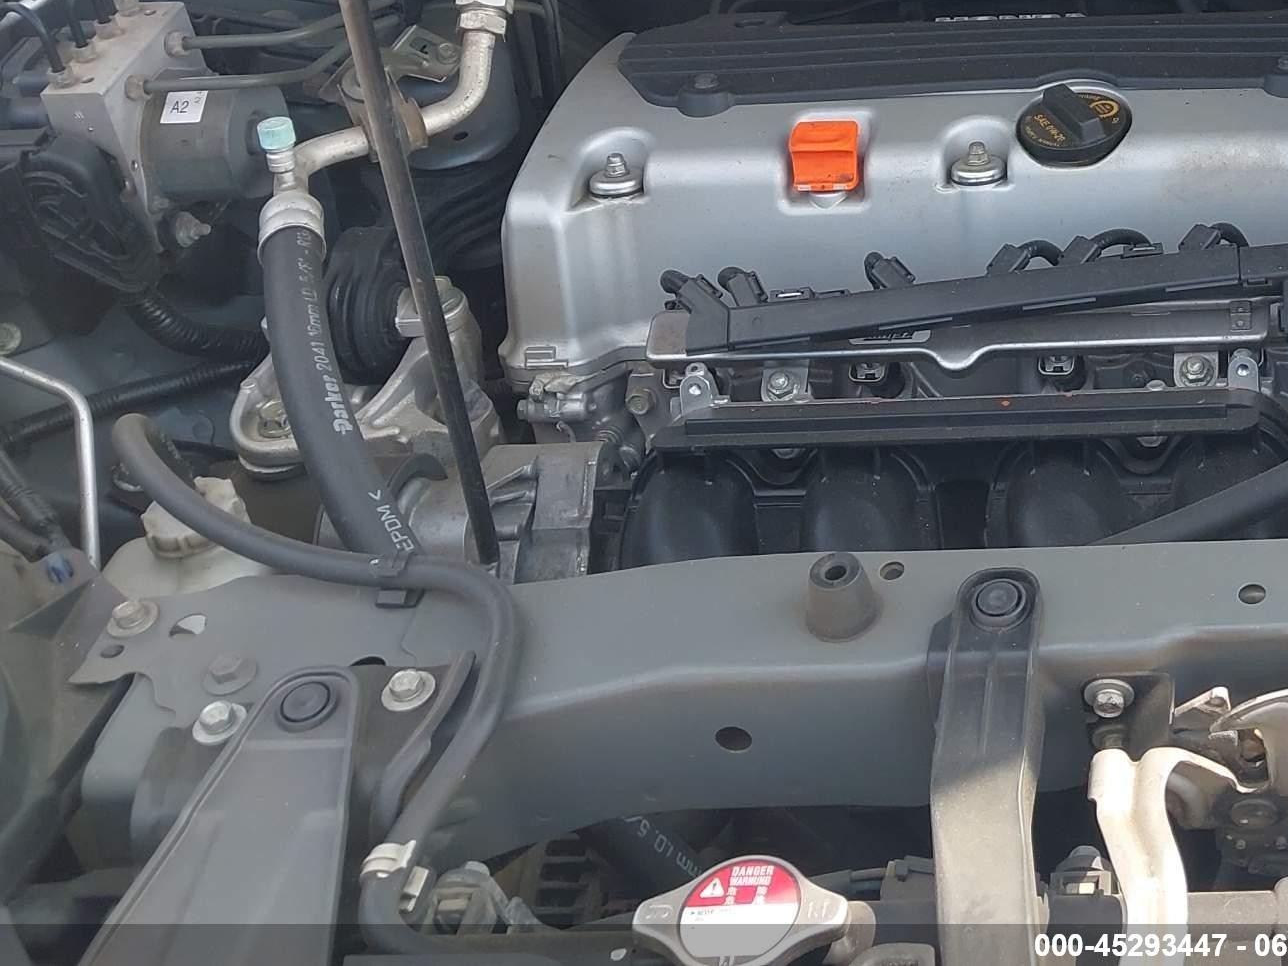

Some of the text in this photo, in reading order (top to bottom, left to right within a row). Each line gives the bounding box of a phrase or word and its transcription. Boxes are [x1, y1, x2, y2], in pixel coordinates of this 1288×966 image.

[170, 100, 190, 114] A2
[310, 341, 332, 371] 2041
[323, 375, 353, 435] Parker
[376, 504, 414, 552] EPDM
[676, 852, 700, 877] mm
[731, 866, 774, 876] DANGER
